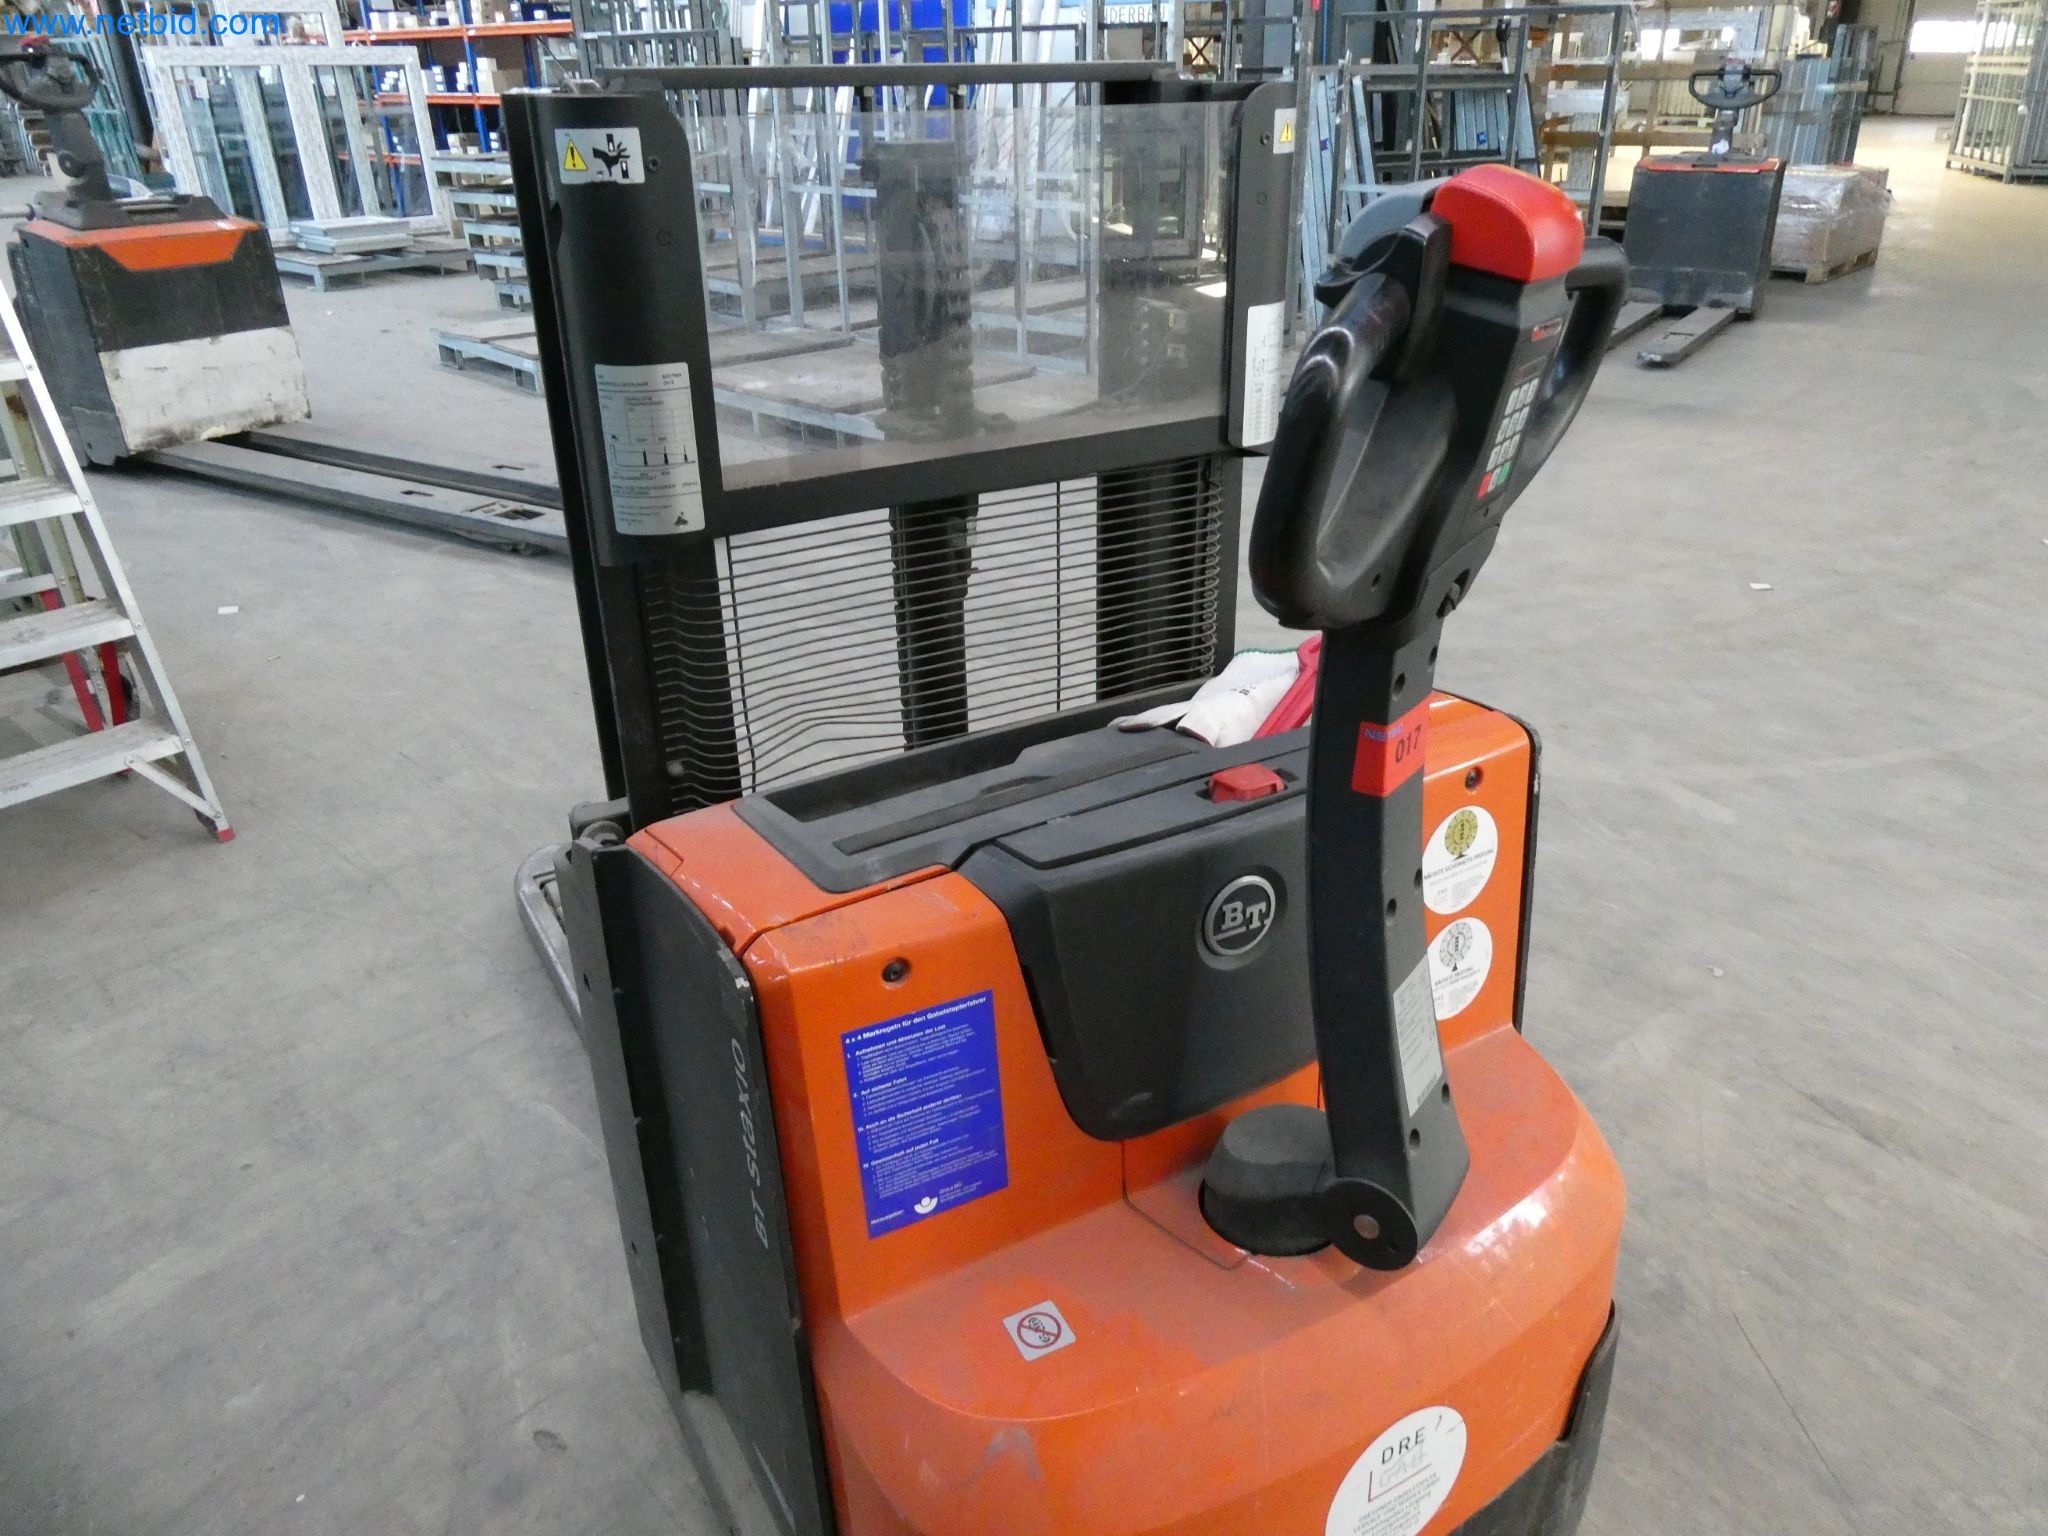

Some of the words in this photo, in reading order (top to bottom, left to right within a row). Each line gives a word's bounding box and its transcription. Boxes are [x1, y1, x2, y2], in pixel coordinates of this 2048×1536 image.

[1395, 724, 1421, 763] 017
[1222, 901, 1267, 930] BT
[751, 1188, 769, 1249] BT
[1382, 1426, 1425, 1465] DRE
